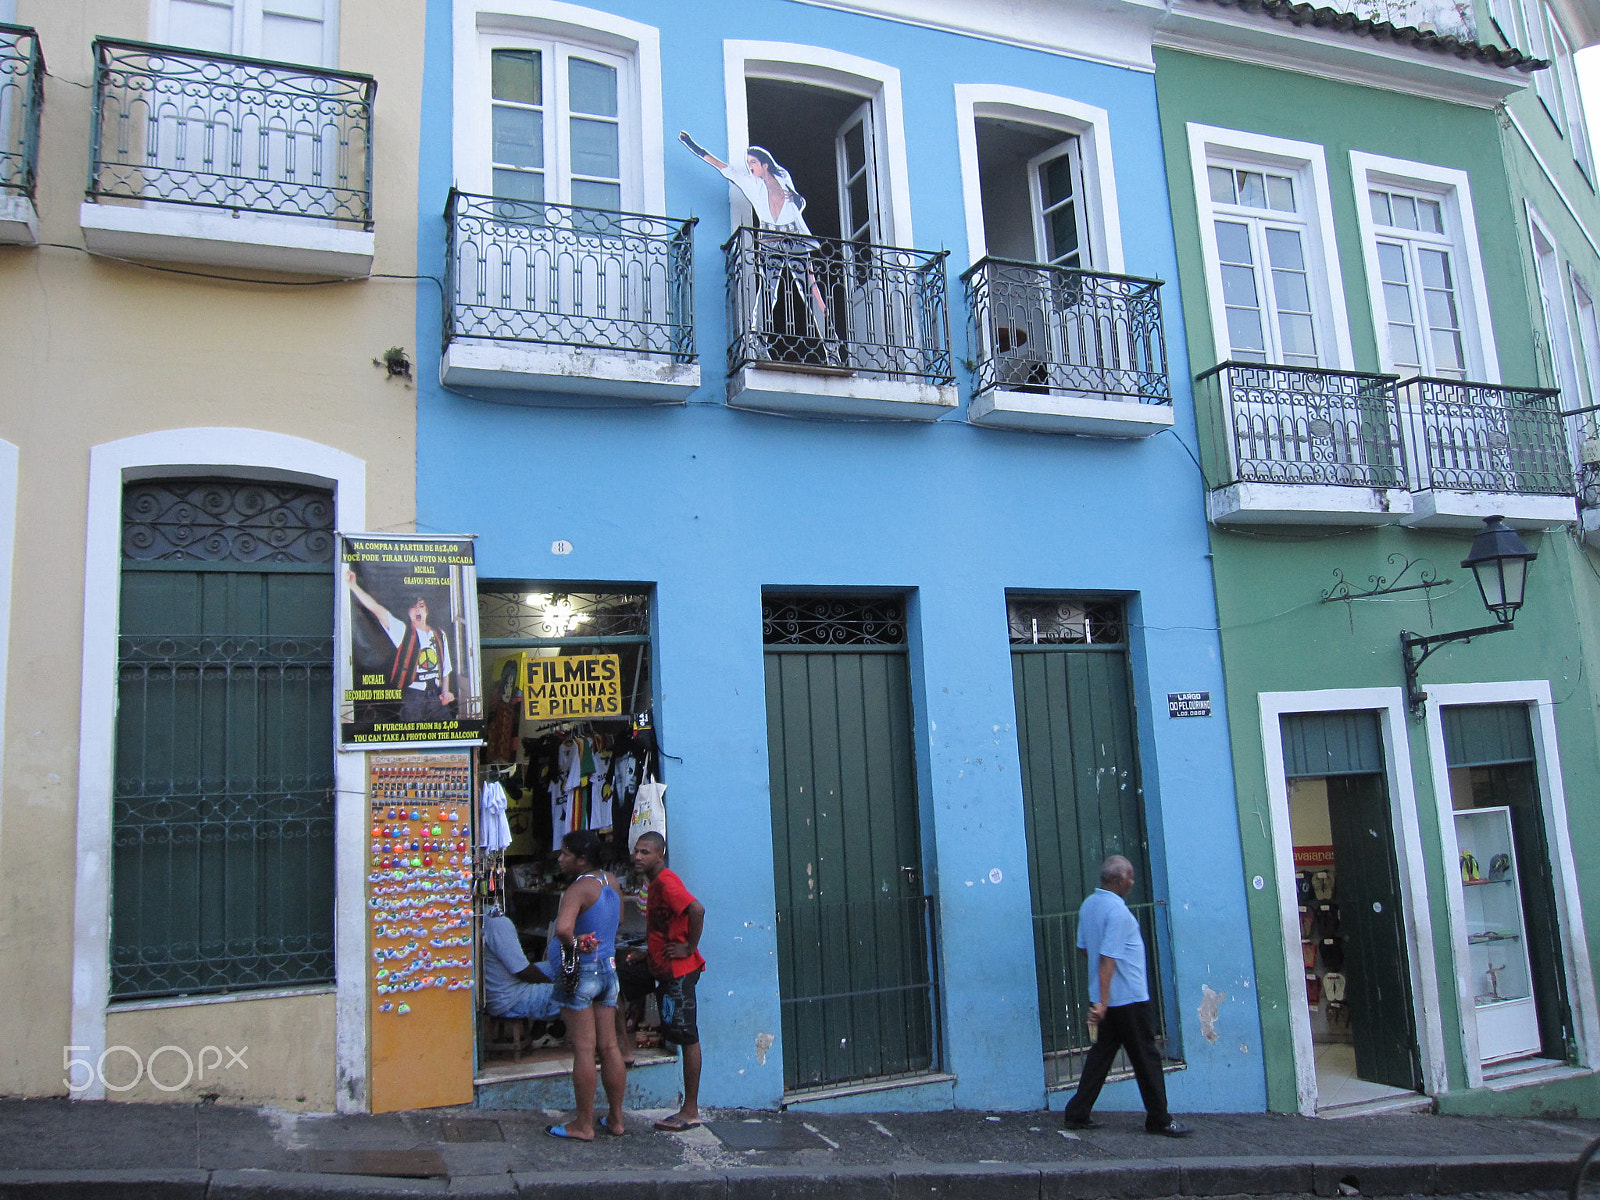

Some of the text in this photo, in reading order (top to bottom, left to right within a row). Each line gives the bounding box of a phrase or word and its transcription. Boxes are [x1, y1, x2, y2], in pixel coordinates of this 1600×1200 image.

[354, 542, 364, 550] NA
[365, 543, 392, 551] COMPRA
[400, 544, 423, 552] PARTIR
[425, 544, 434, 552] DE
[435, 544, 458, 554] R$2,00
[558, 542, 564, 552] 8
[343, 551, 473, 564] VOCÊ PODE TIRAR UMA FOTO NA SACADA
[414, 566, 435, 574] MICHAEL
[404, 577, 424, 585] GRAVOU
[424, 577, 440, 585] NESTA
[527, 659, 616, 684] FILMES
[362, 674, 385, 685] MICHAEL
[345, 689, 402, 701] RECORDED THIS HOUSE
[527, 682, 617, 699] MAQUINAS
[1177, 693, 1201, 701] LARGO
[529, 696, 618, 716] E PILHAS
[1169, 700, 1211, 711] DO PELOURINHO
[374, 723, 382, 732] IN
[382, 723, 414, 732] PURCHASE
[415, 723, 433, 731] FROM
[442, 721, 459, 732] 2,00
[354, 731, 479, 742] YOU CAN TAKE A PHOTO ON THE BALCONY
